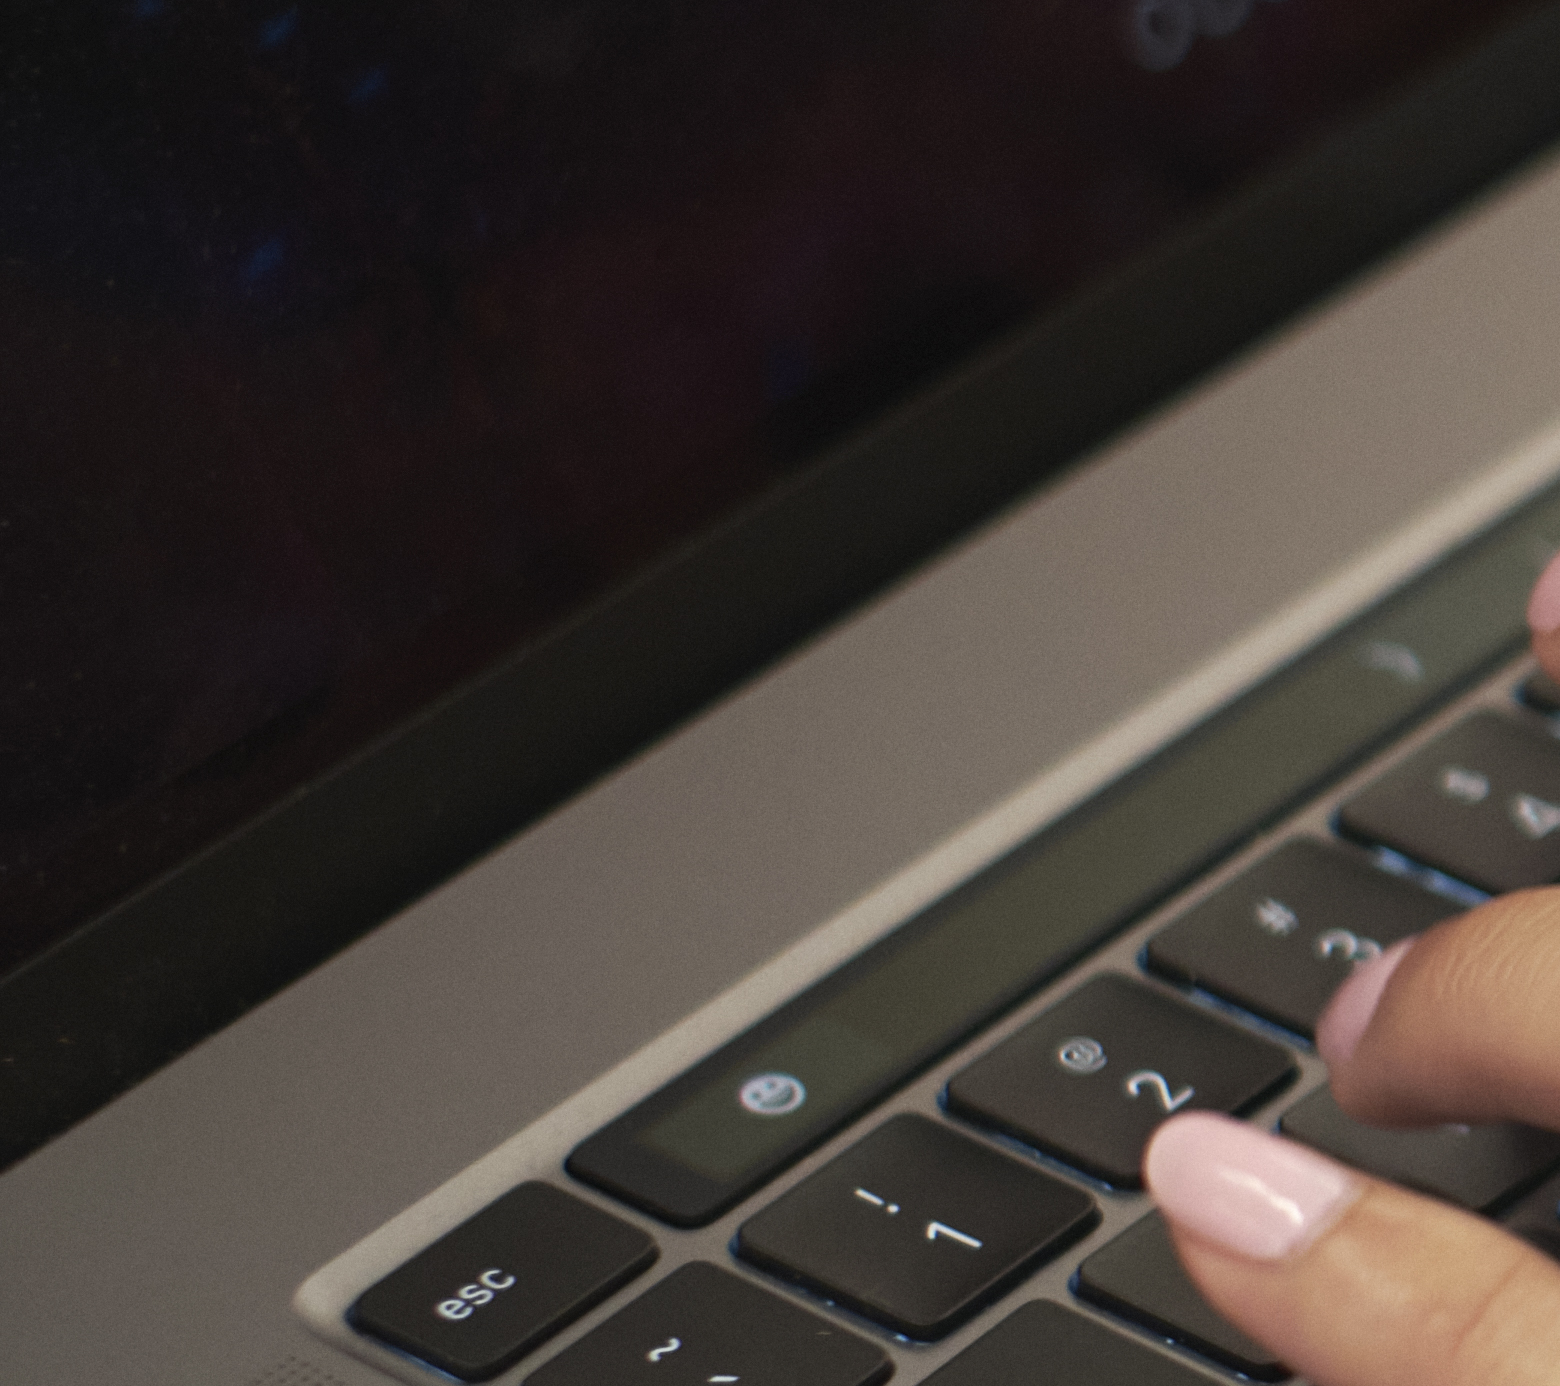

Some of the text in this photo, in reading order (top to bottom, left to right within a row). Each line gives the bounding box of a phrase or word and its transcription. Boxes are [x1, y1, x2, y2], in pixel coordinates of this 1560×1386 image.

[1057, 1037, 1107, 1074] @
[1126, 1070, 1196, 1111] 2
[855, 1188, 900, 1214] !
[926, 1221, 983, 1249] 1
[436, 1268, 517, 1321] esc
